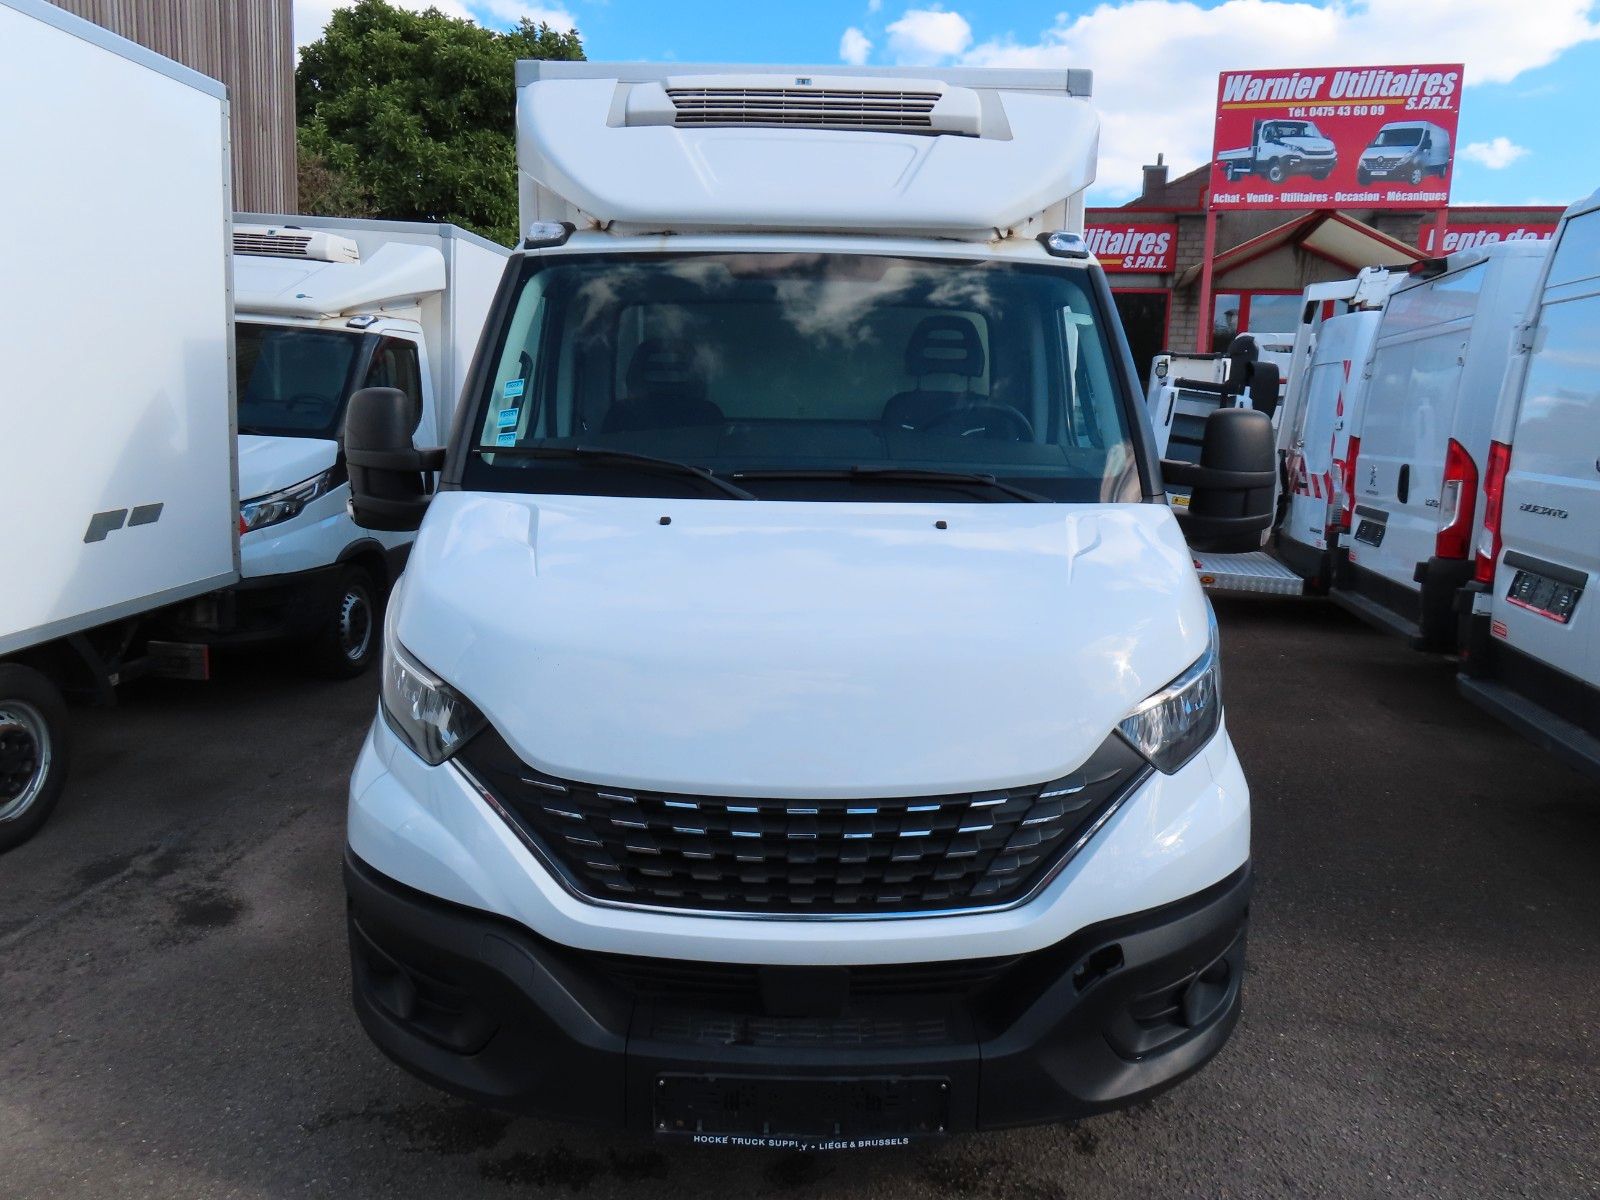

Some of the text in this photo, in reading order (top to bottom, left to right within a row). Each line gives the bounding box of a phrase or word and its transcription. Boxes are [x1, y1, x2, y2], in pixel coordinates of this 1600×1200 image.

[1222, 69, 1458, 102] Warnier Utilitaires
[1405, 97, 1453, 111] S.P.R.L.
[1309, 106, 1334, 117] 0475
[1336, 106, 1351, 116] 43
[1353, 105, 1369, 116] 60
[1370, 105, 1385, 116] 09
[1213, 193, 1241, 203] Achat
[1246, 192, 1274, 203] Vente
[1280, 191, 1328, 202] Utilitaires
[1334, 191, 1380, 202] Occasion
[1386, 190, 1447, 202] Mécaniques
[1123, 255, 1167, 268] S.P.R.L.
[731, 1137, 766, 1146] TRUCK
[858, 1137, 909, 1148] BRUSSELS
